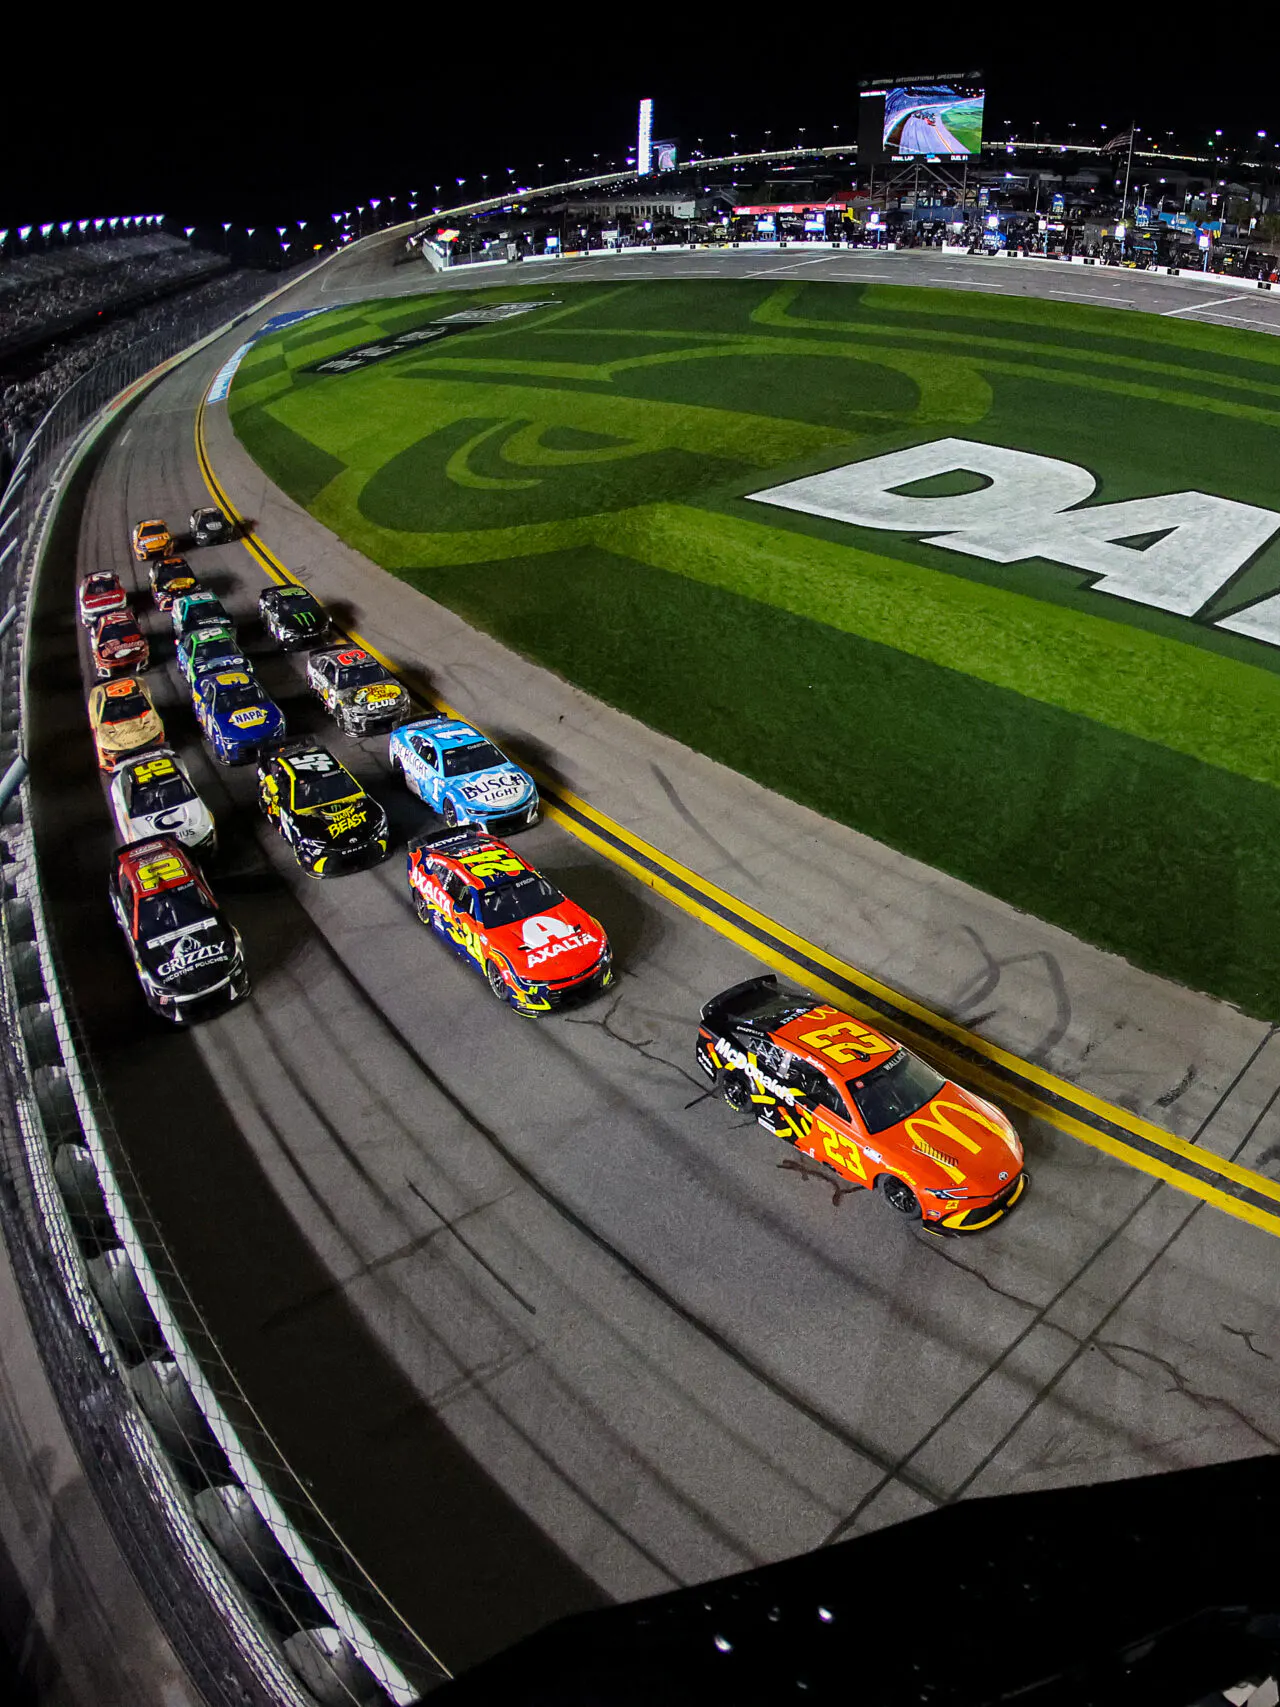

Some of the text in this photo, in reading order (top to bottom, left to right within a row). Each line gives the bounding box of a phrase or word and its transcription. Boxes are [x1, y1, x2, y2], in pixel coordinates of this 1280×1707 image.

[337, 649, 366, 665] 3
[234, 710, 263, 723] NAPA
[367, 698, 397, 711] CLUB
[461, 773, 529, 800] BUSCH
[484, 787, 520, 802] LIGHT
[327, 811, 367, 839] BEAST
[136, 857, 189, 892] 10
[458, 849, 525, 877] 24
[411, 867, 452, 917] AXALTA
[156, 941, 225, 976] GRIZZLY
[526, 933, 598, 968] AXALTA
[798, 1021, 894, 1065] 23
[714, 1037, 795, 1107] McDonald's
[883, 1051, 907, 1072] WALLACE
[816, 1119, 868, 1181] 23
